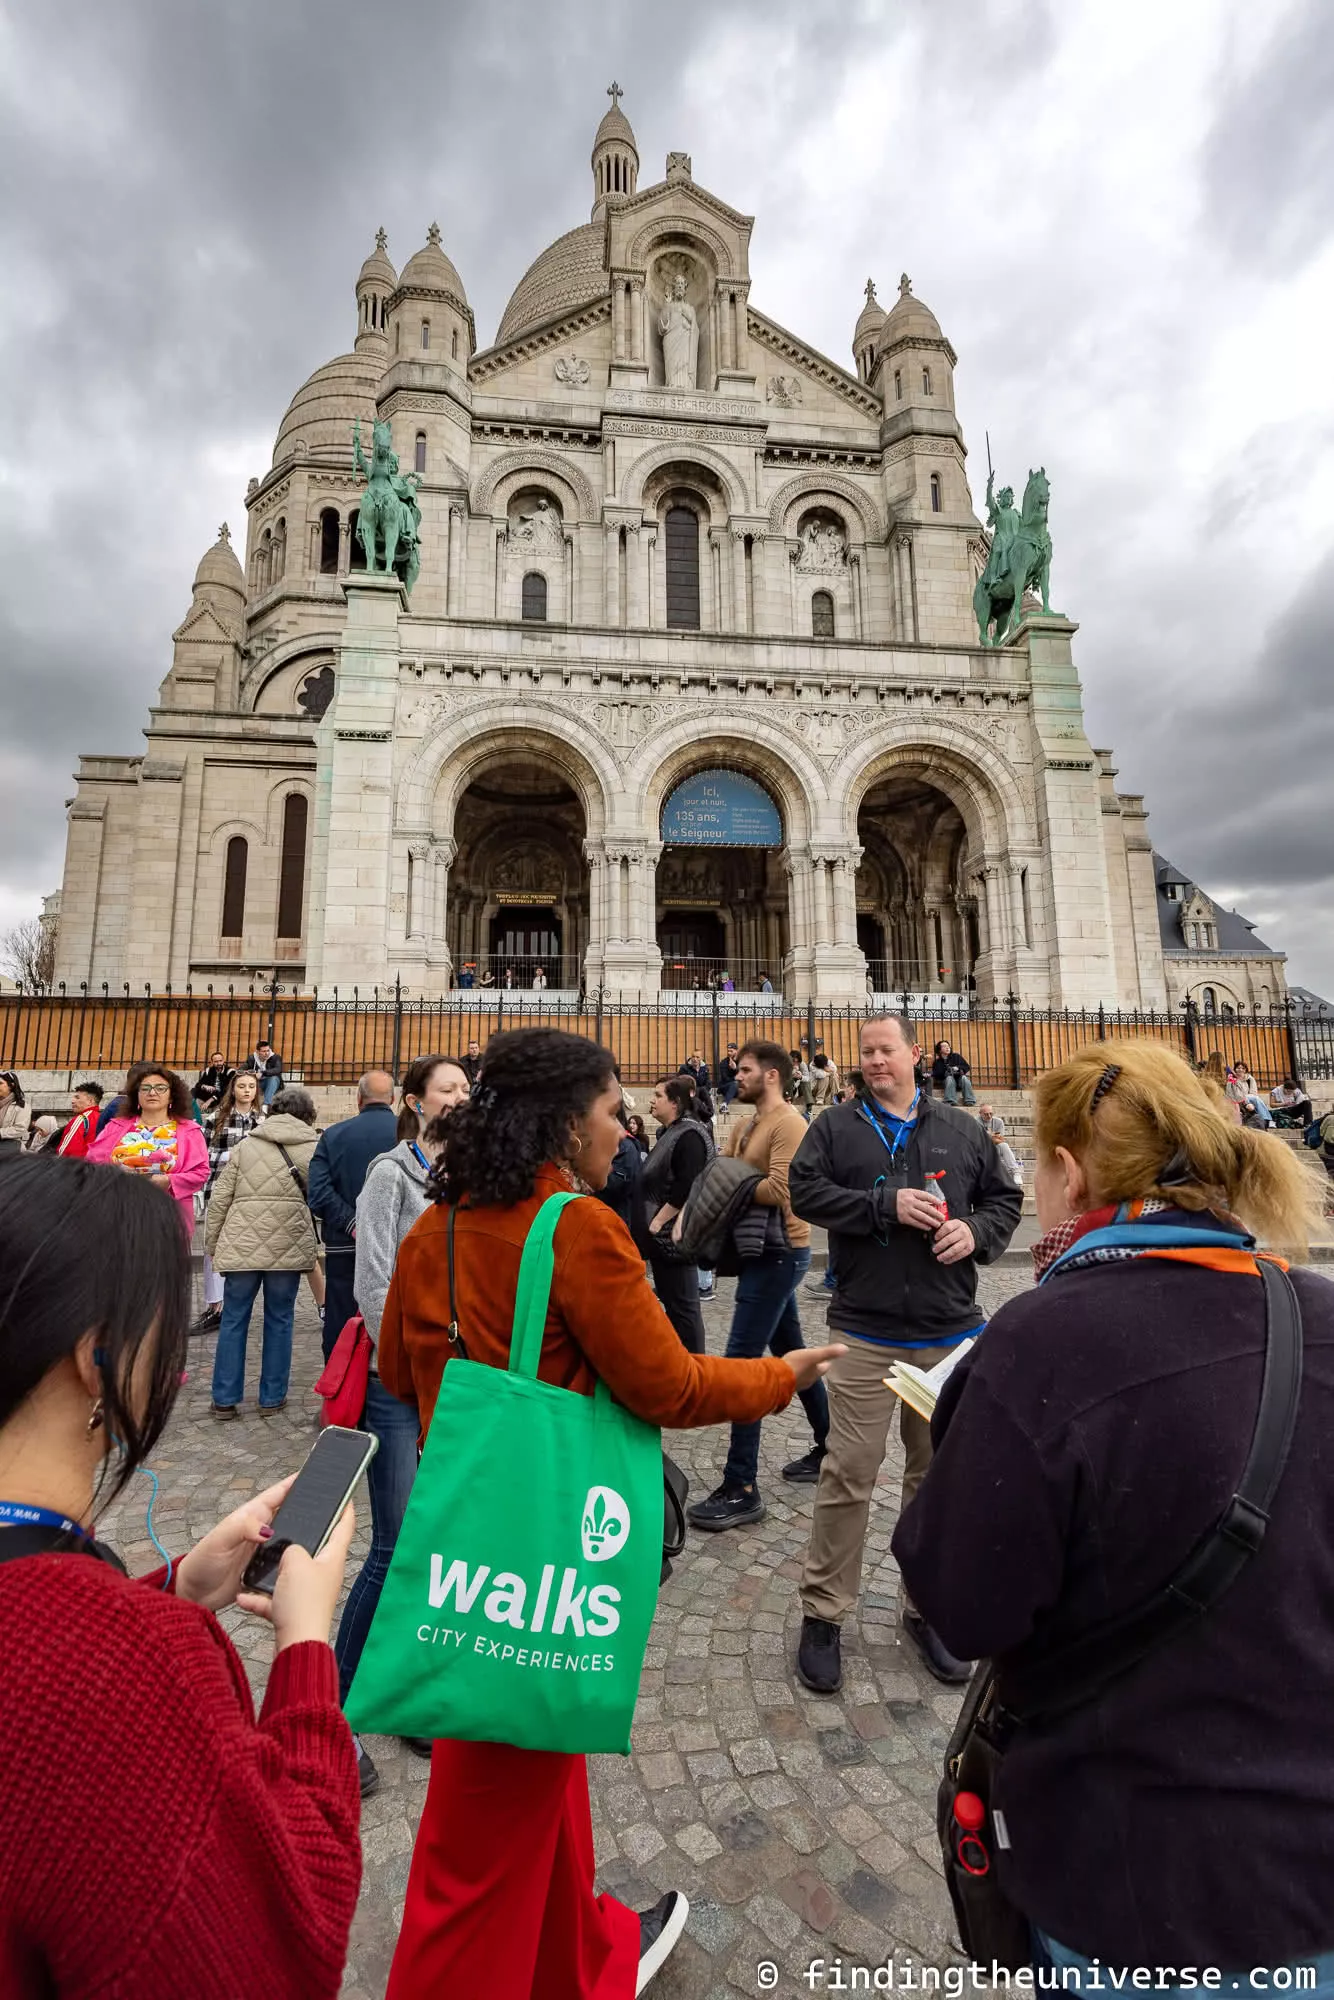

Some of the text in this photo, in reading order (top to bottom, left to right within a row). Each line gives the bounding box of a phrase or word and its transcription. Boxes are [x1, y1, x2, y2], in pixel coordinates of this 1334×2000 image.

[703, 786, 720, 798] Ici,
[683, 799, 699, 807] jour
[710, 799, 727, 807] nuit,
[676, 811, 720, 823] 135 ans,
[669, 828, 727, 840] le Seigneur
[428, 1553, 622, 1637] walks
[416, 1625, 615, 1672] CITY EXPERIENCES
